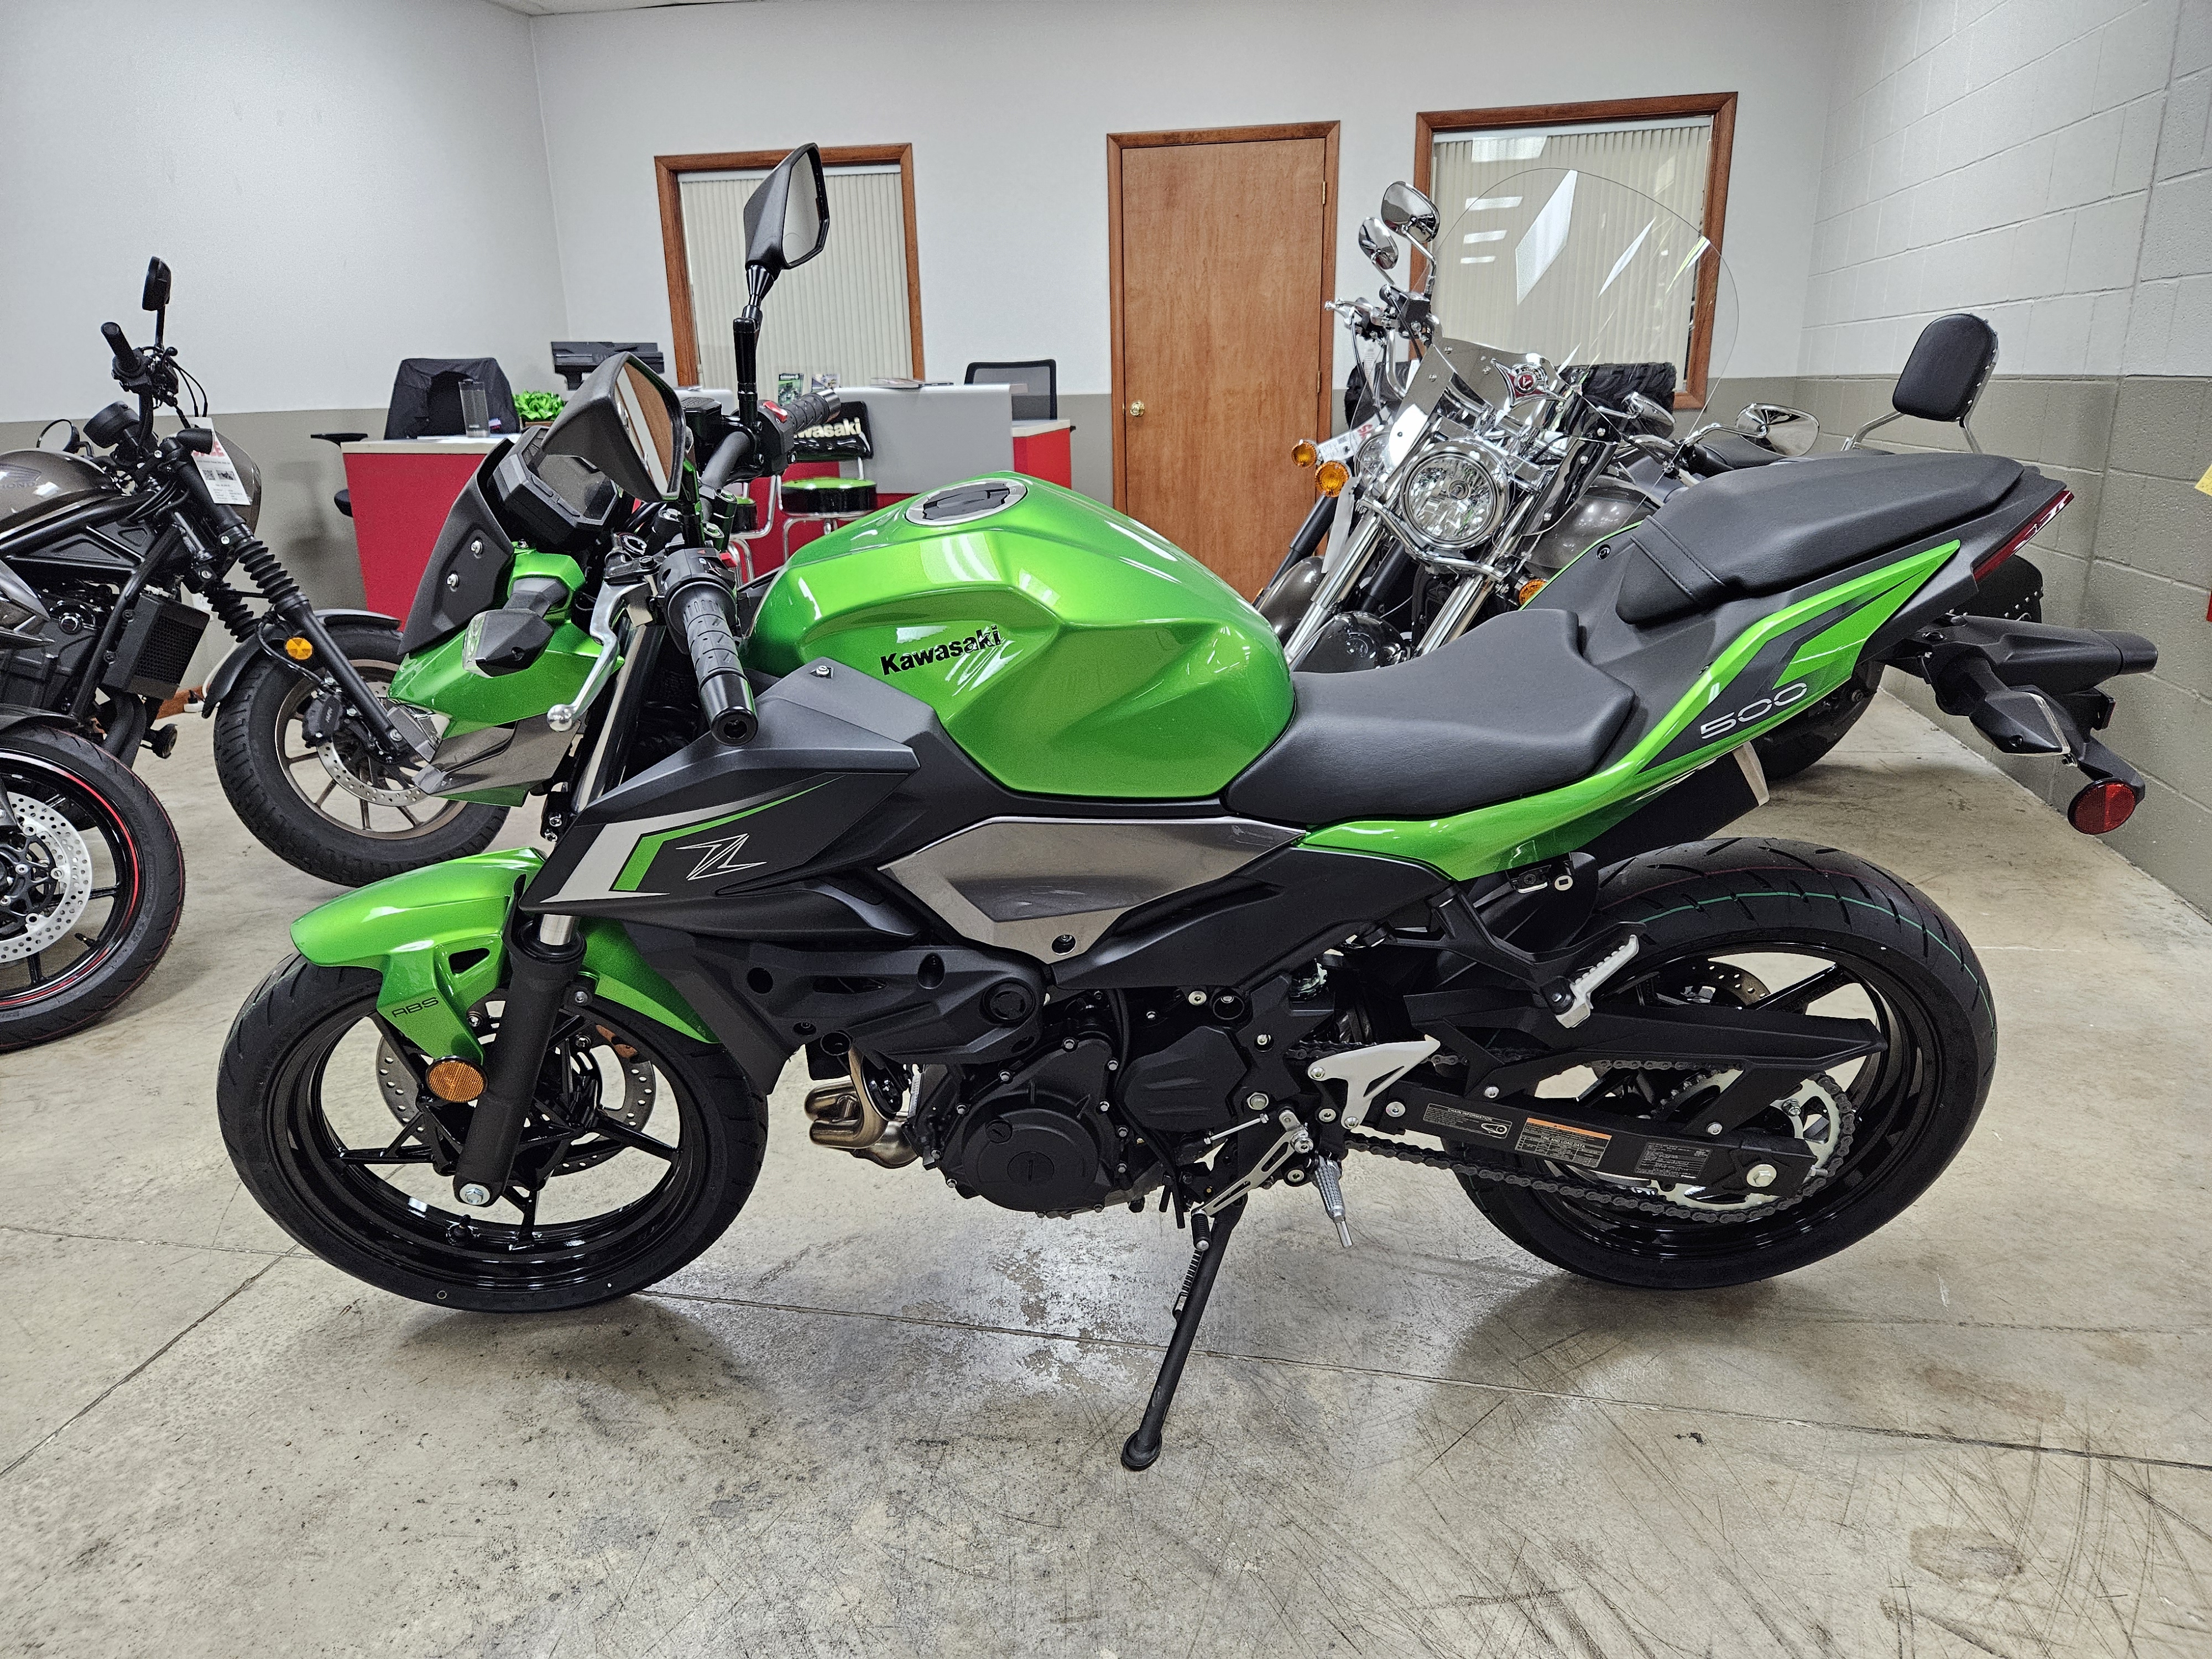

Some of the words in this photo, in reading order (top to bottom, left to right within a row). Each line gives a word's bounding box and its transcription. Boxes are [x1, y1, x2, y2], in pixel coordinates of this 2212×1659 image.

[794, 417, 862, 438] wasaki
[880, 625, 1001, 676] Kawasaki
[1700, 683, 1807, 739] 500
[392, 997, 439, 1018] ABS
[1462, 1112, 1493, 1121] INFORMATION
